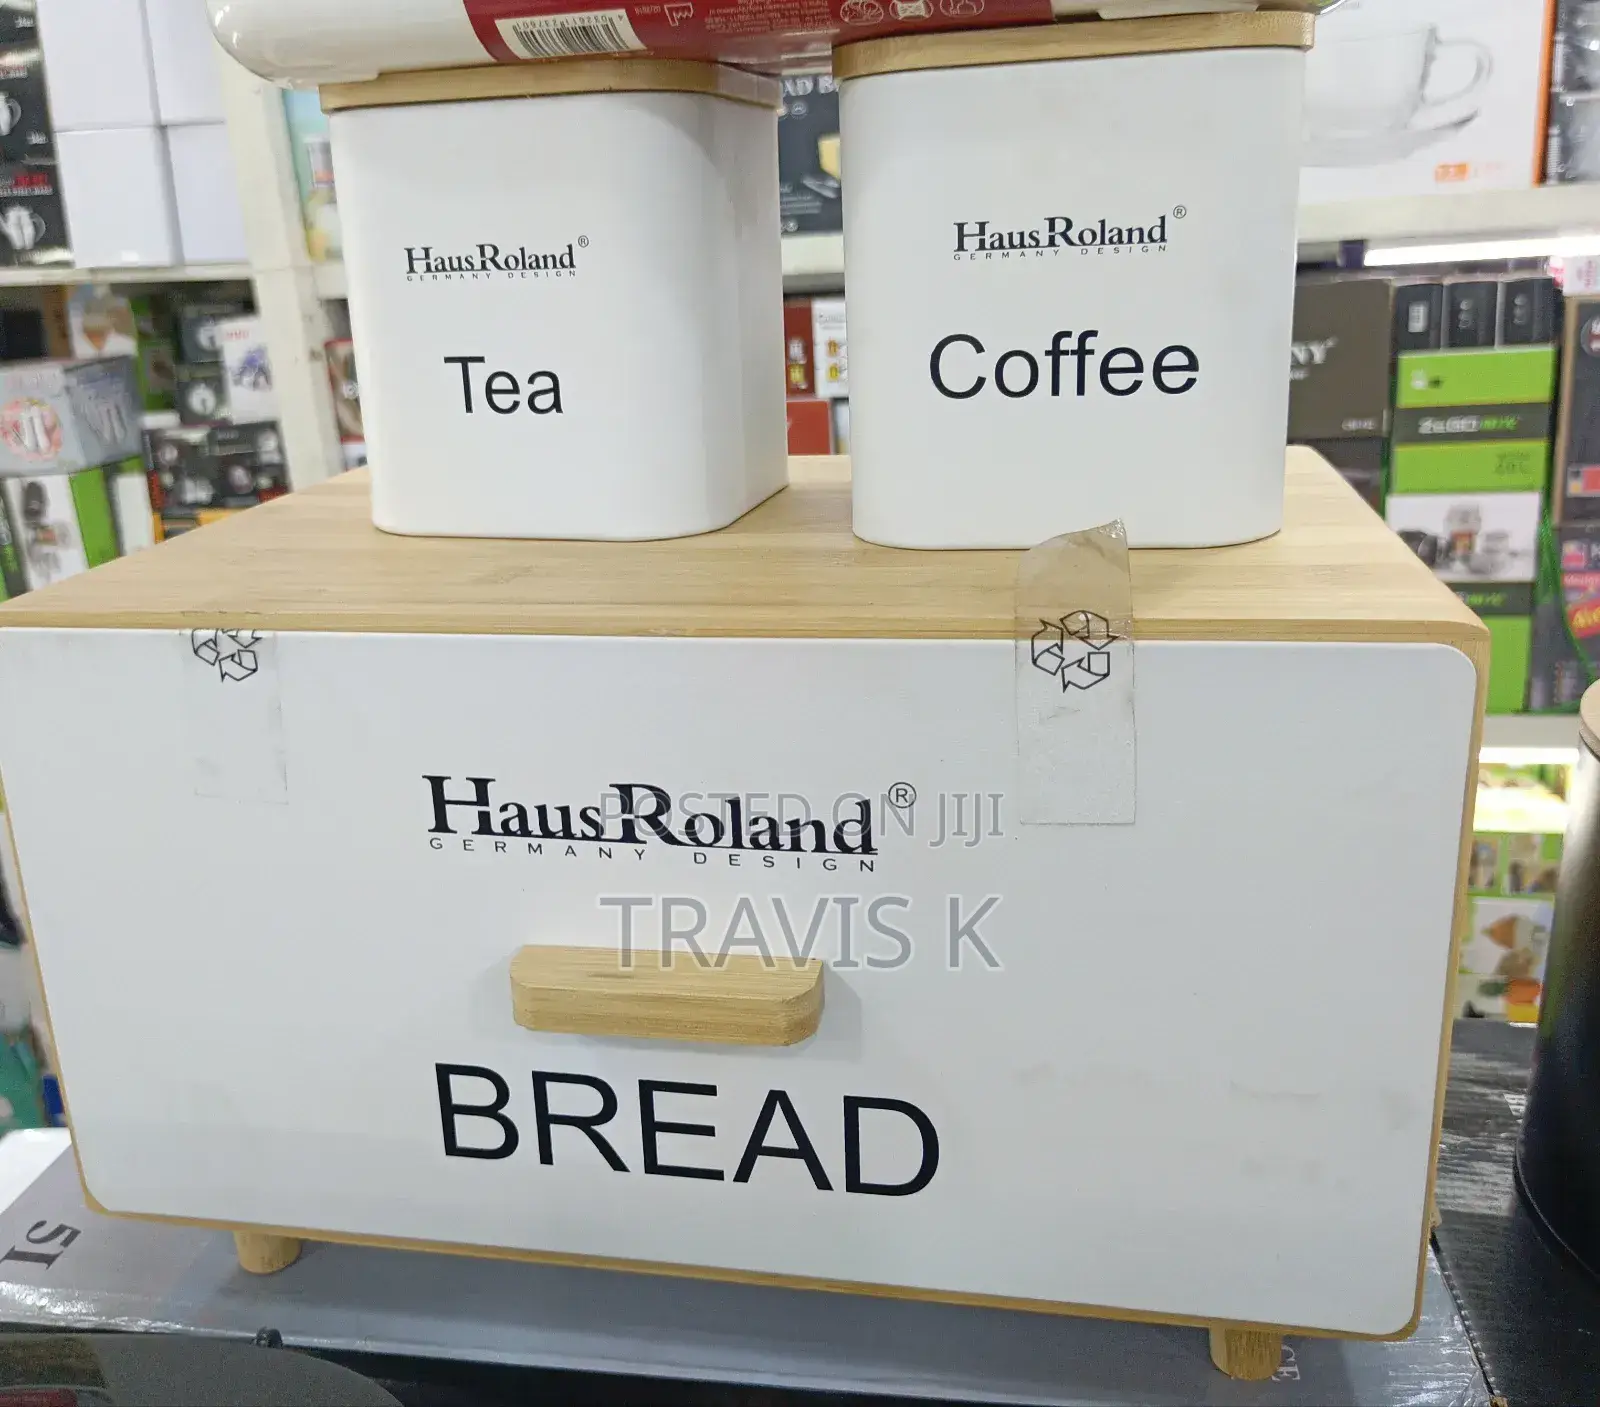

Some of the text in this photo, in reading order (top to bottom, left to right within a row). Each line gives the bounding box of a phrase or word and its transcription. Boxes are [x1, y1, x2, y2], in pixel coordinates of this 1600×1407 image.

[952, 214, 1168, 252] HausRoland
[403, 243, 577, 275] HausRoland
[953, 244, 1167, 261] GERMANY DESIGN
[406, 270, 577, 282] GERMANY DESIGN
[929, 329, 1200, 400] Coffee
[443, 355, 564, 415] Tea
[421, 774, 878, 855] HausRoland
[429, 837, 876, 873] GERMANY DESIGN
[434, 1061, 940, 1197] BREAD
